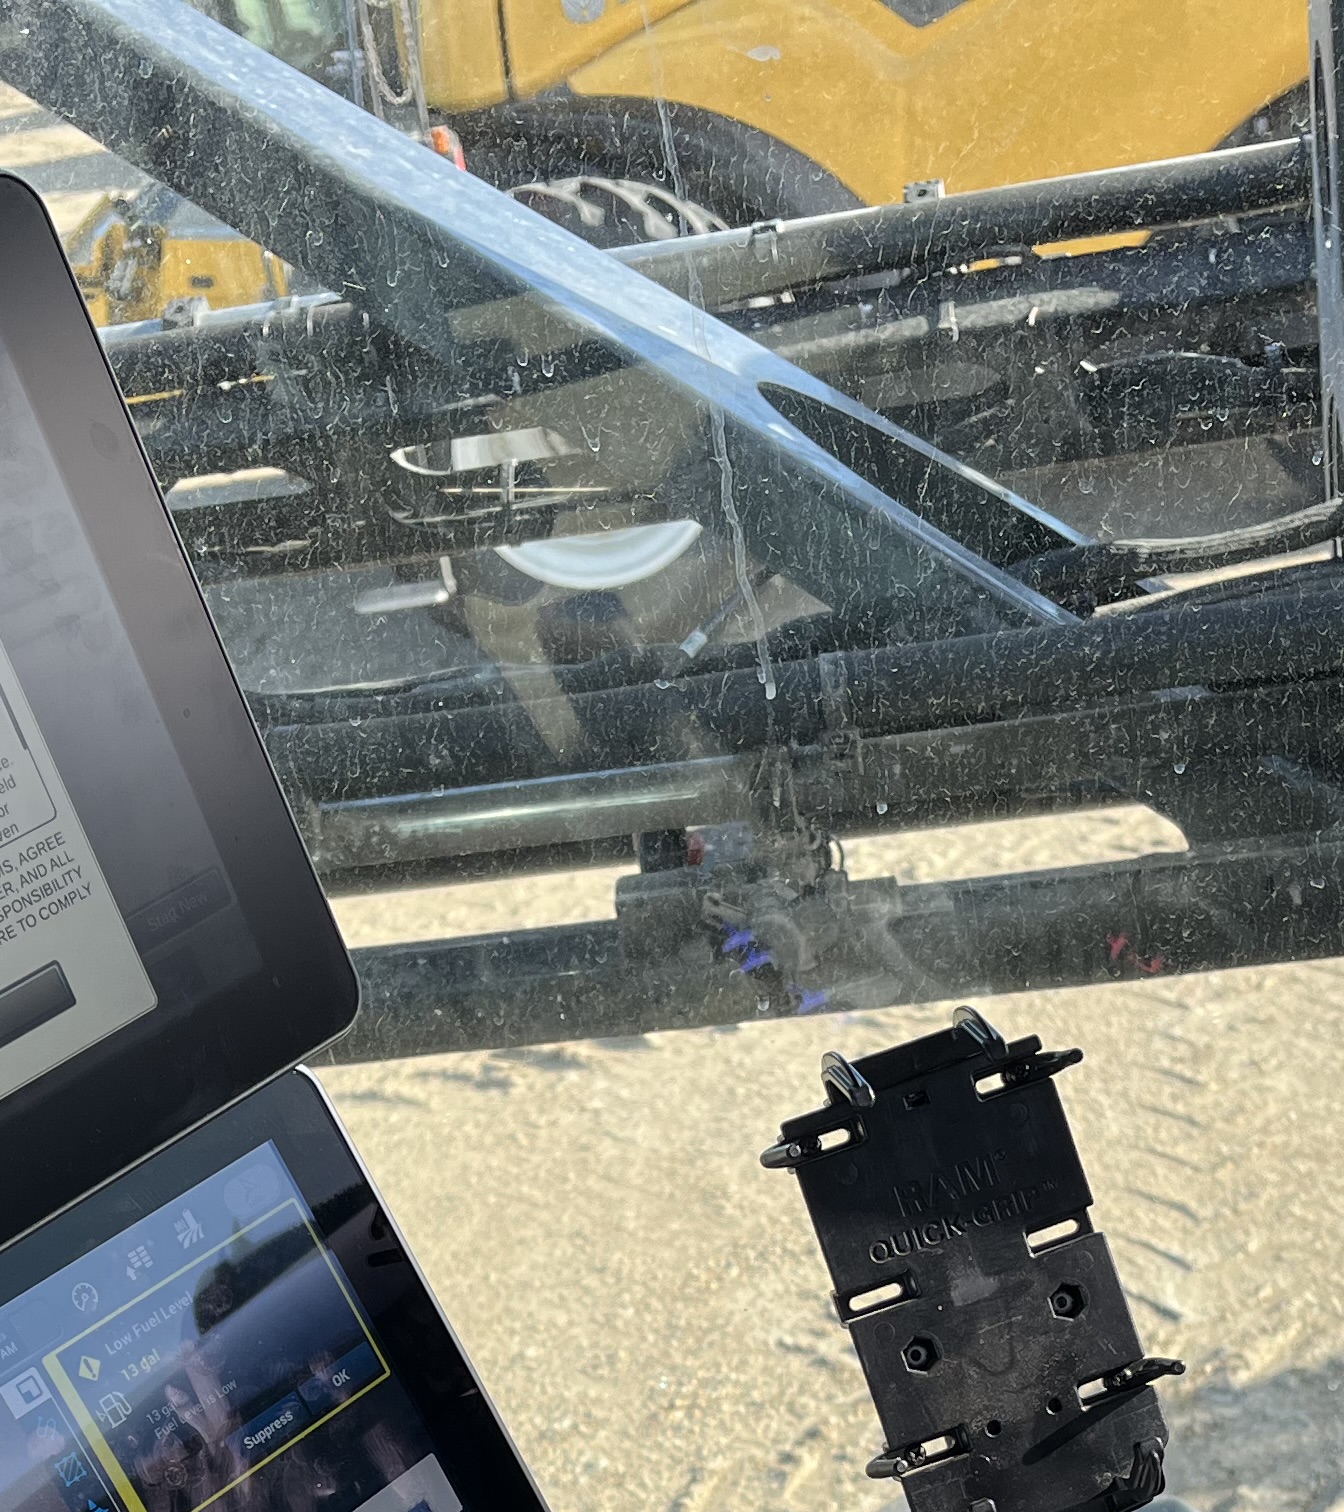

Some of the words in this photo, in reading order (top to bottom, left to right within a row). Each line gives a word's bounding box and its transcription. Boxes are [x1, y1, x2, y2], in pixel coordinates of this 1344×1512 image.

[17, 830, 66, 867] AGREE
[104, 1332, 132, 1355] Low
[131, 1310, 161, 1337] Fuel
[159, 1290, 194, 1319] Level
[0, 1341, 18, 1360] AM
[120, 1363, 139, 1380] 13
[139, 1348, 160, 1373] gal
[145, 1409, 161, 1424] 13
[154, 1416, 178, 1439] Fuel
[214, 1379, 236, 1398] Low
[243, 1410, 293, 1449] Suppress
[331, 1368, 350, 1386] OK
